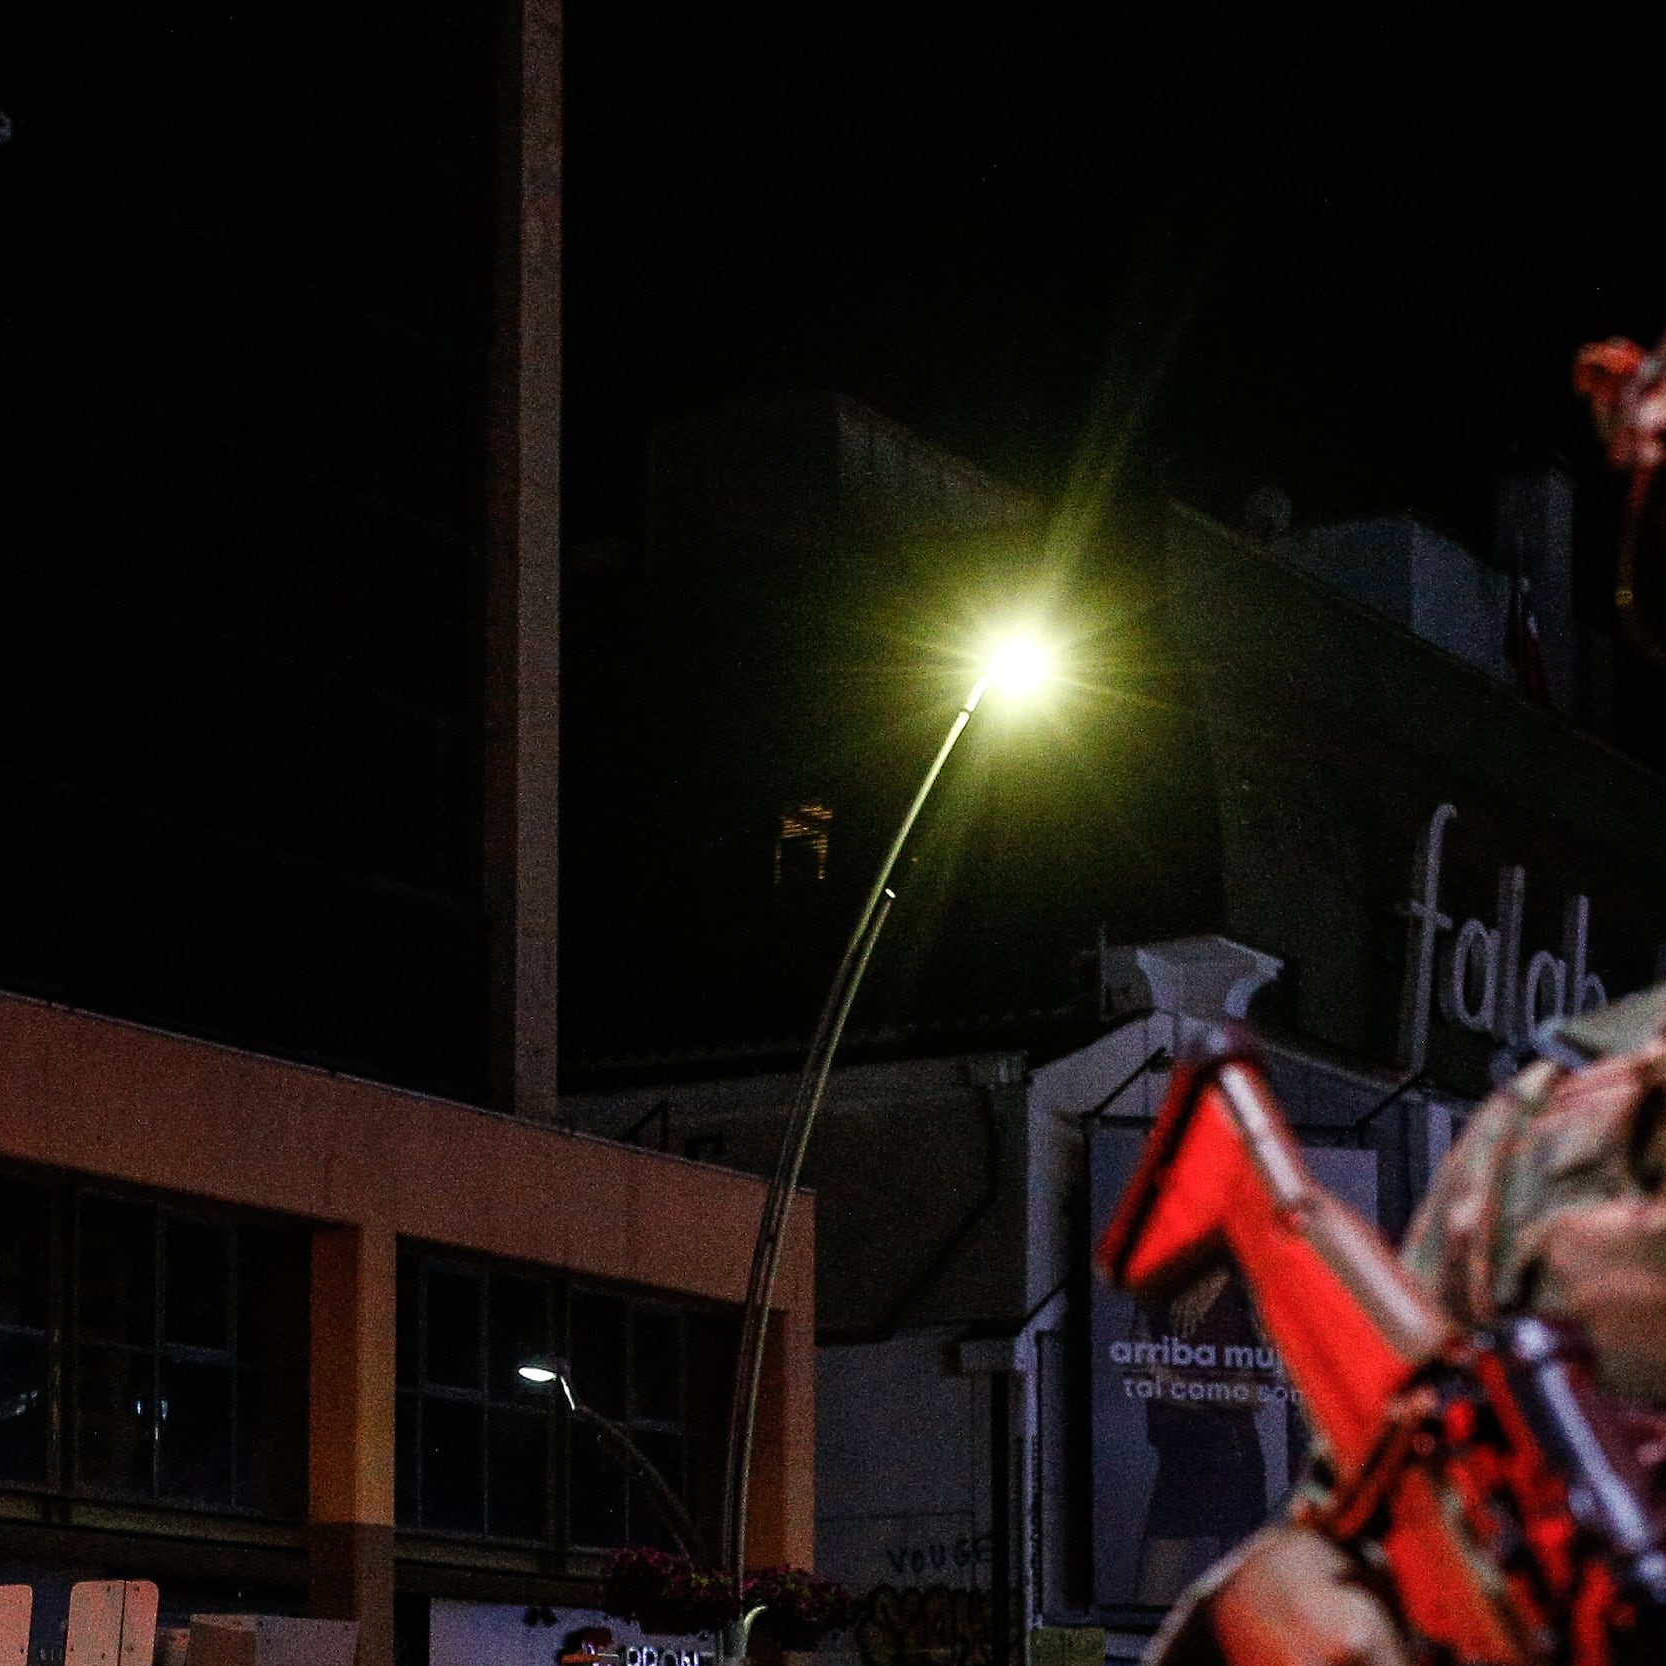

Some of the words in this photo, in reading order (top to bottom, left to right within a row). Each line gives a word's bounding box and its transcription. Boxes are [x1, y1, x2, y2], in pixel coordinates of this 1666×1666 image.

[1109, 1335, 1218, 1367] arriba
[1223, 1345, 1281, 1375] mu
[1170, 1381, 1251, 1402] como
